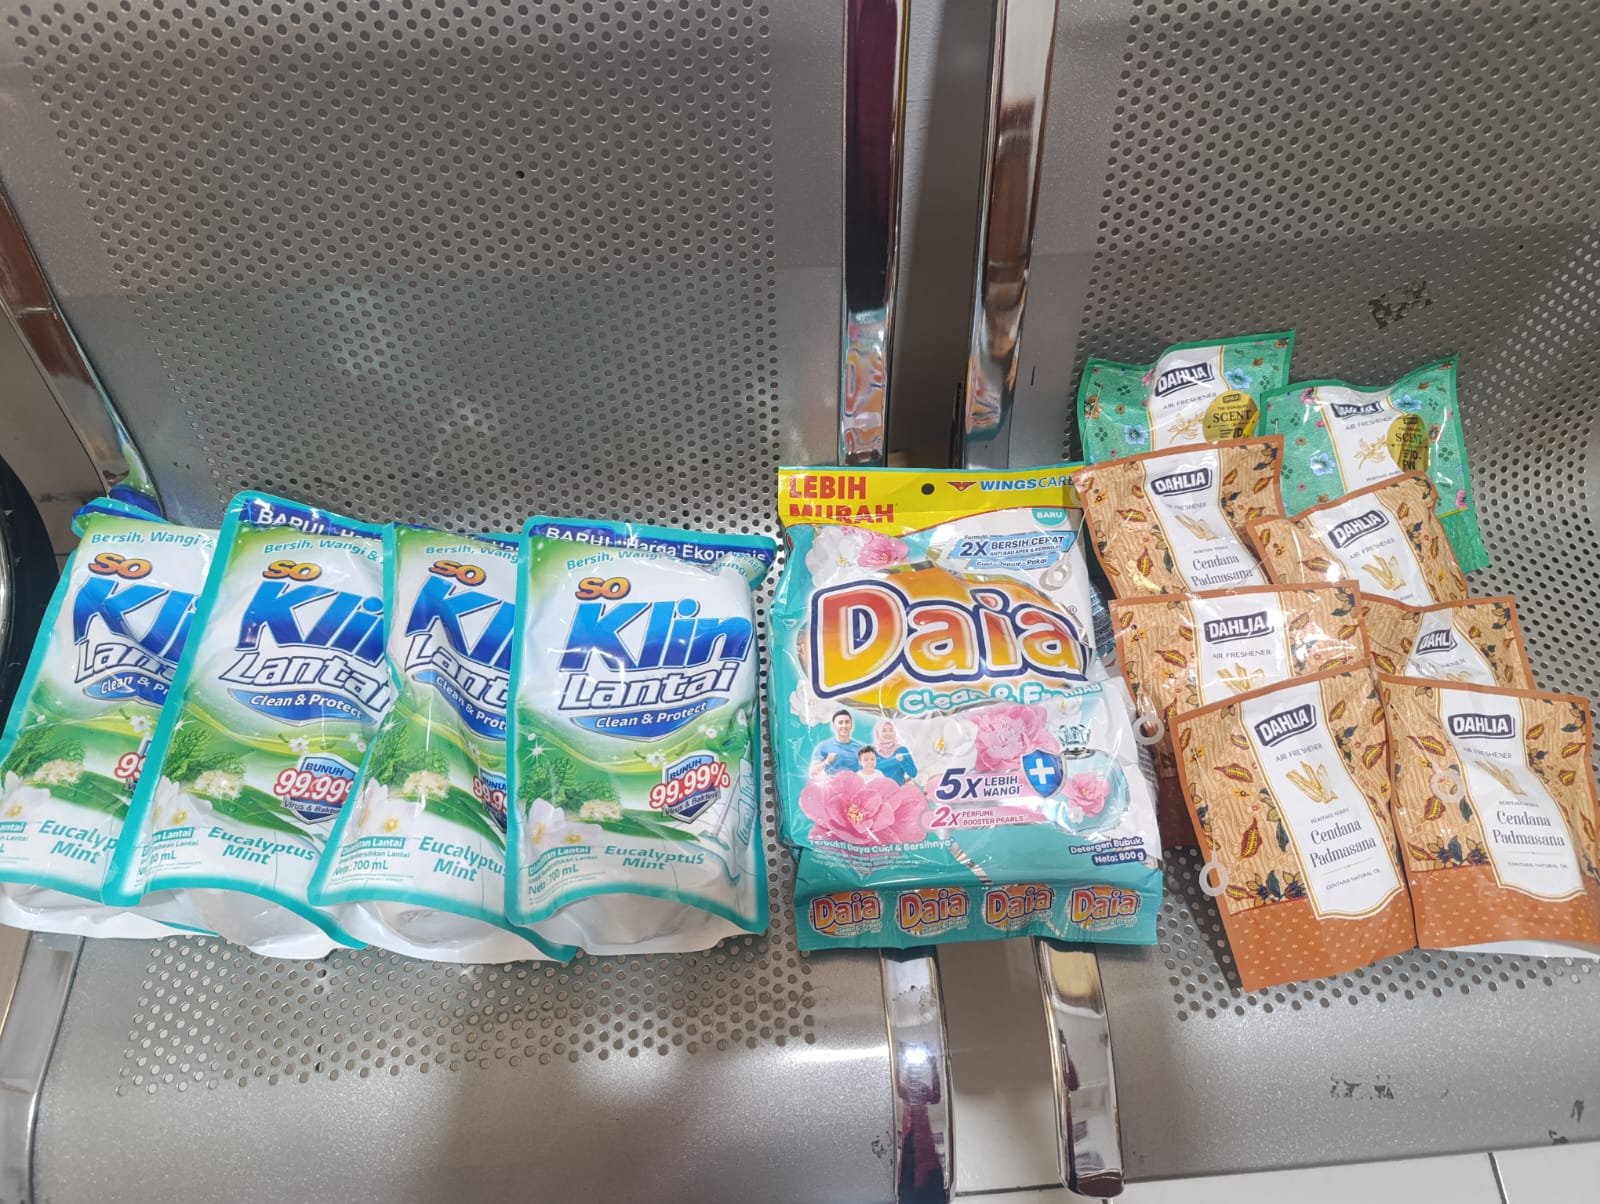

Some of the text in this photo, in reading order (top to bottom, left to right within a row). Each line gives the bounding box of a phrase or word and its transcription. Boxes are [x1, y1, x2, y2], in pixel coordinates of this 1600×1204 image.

[1157, 366, 1208, 392] DAHLIA
[1212, 410, 1252, 424] SCENT
[789, 476, 867, 500] LEBIH
[1155, 471, 1206, 492] DAHLIA
[789, 504, 895, 523] MURAH
[1036, 511, 1063, 519] BARU
[91, 531, 144, 545] Bersih,
[151, 531, 202, 548] Wangi
[1332, 512, 1381, 547] DAHLIA
[264, 539, 378, 562] Bersih, Wangi &
[426, 545, 476, 555] Bersih,
[959, 541, 990, 557] 2X
[991, 538, 1029, 550] BERSIH
[1031, 536, 1065, 546] CEPAT
[1362, 538, 1396, 554] FRESHENER
[567, 551, 614, 571] Bersih,
[1193, 554, 1240, 571] Cendana
[1191, 568, 1253, 587] Padmasana
[559, 598, 754, 673] Klin
[1208, 615, 1266, 639] DAHLIA
[811, 579, 1088, 699] Daia
[1226, 649, 1272, 659] FRESHENER
[100, 675, 151, 695] Clean &
[559, 661, 740, 711] Lantai
[435, 676, 467, 707] Clean
[465, 704, 474, 715] &
[250, 694, 365, 720] Clean & Protect
[595, 701, 708, 730] Clean & Protect
[1259, 708, 1310, 743] DAHLIA
[1453, 716, 1510, 735] DAHLIA
[1275, 743, 1323, 763] AIR FRESHENER
[304, 761, 345, 777] BUNUH
[670, 757, 703, 780] BUNUH
[649, 762, 731, 810] 99.99%
[984, 776, 1018, 787] LEBIH
[284, 799, 306, 811] Virus
[307, 804, 314, 812] &
[665, 804, 683, 816] Virus
[962, 810, 993, 818] PERFUME
[963, 815, 1024, 826] BOOSTER PEARLS
[1497, 810, 1552, 827] Cendana
[162, 827, 193, 840] Lantai
[1310, 818, 1362, 846] Cendana
[1493, 829, 1566, 847] Padmasana
[51, 840, 101, 864] Mint
[208, 825, 316, 862] Eucalyptus
[371, 837, 404, 849] Lantai
[847, 843, 870, 853] Daya
[894, 843, 902, 851] &
[1070, 836, 1142, 854] Detergen Bubuk
[1309, 836, 1377, 869] Padmasana
[222, 843, 272, 866] Mint
[605, 845, 705, 866] Eucalyptus
[622, 857, 666, 872] Mint
[1095, 851, 1145, 864] Neto: 800 g
[371, 859, 390, 871] mL
[433, 858, 478, 882] Mint
[562, 863, 580, 876] mL
[813, 891, 880, 930] Daia
[899, 889, 968, 930] Daia
[986, 886, 1054, 924] Daia
[1070, 889, 1139, 923] Daia
